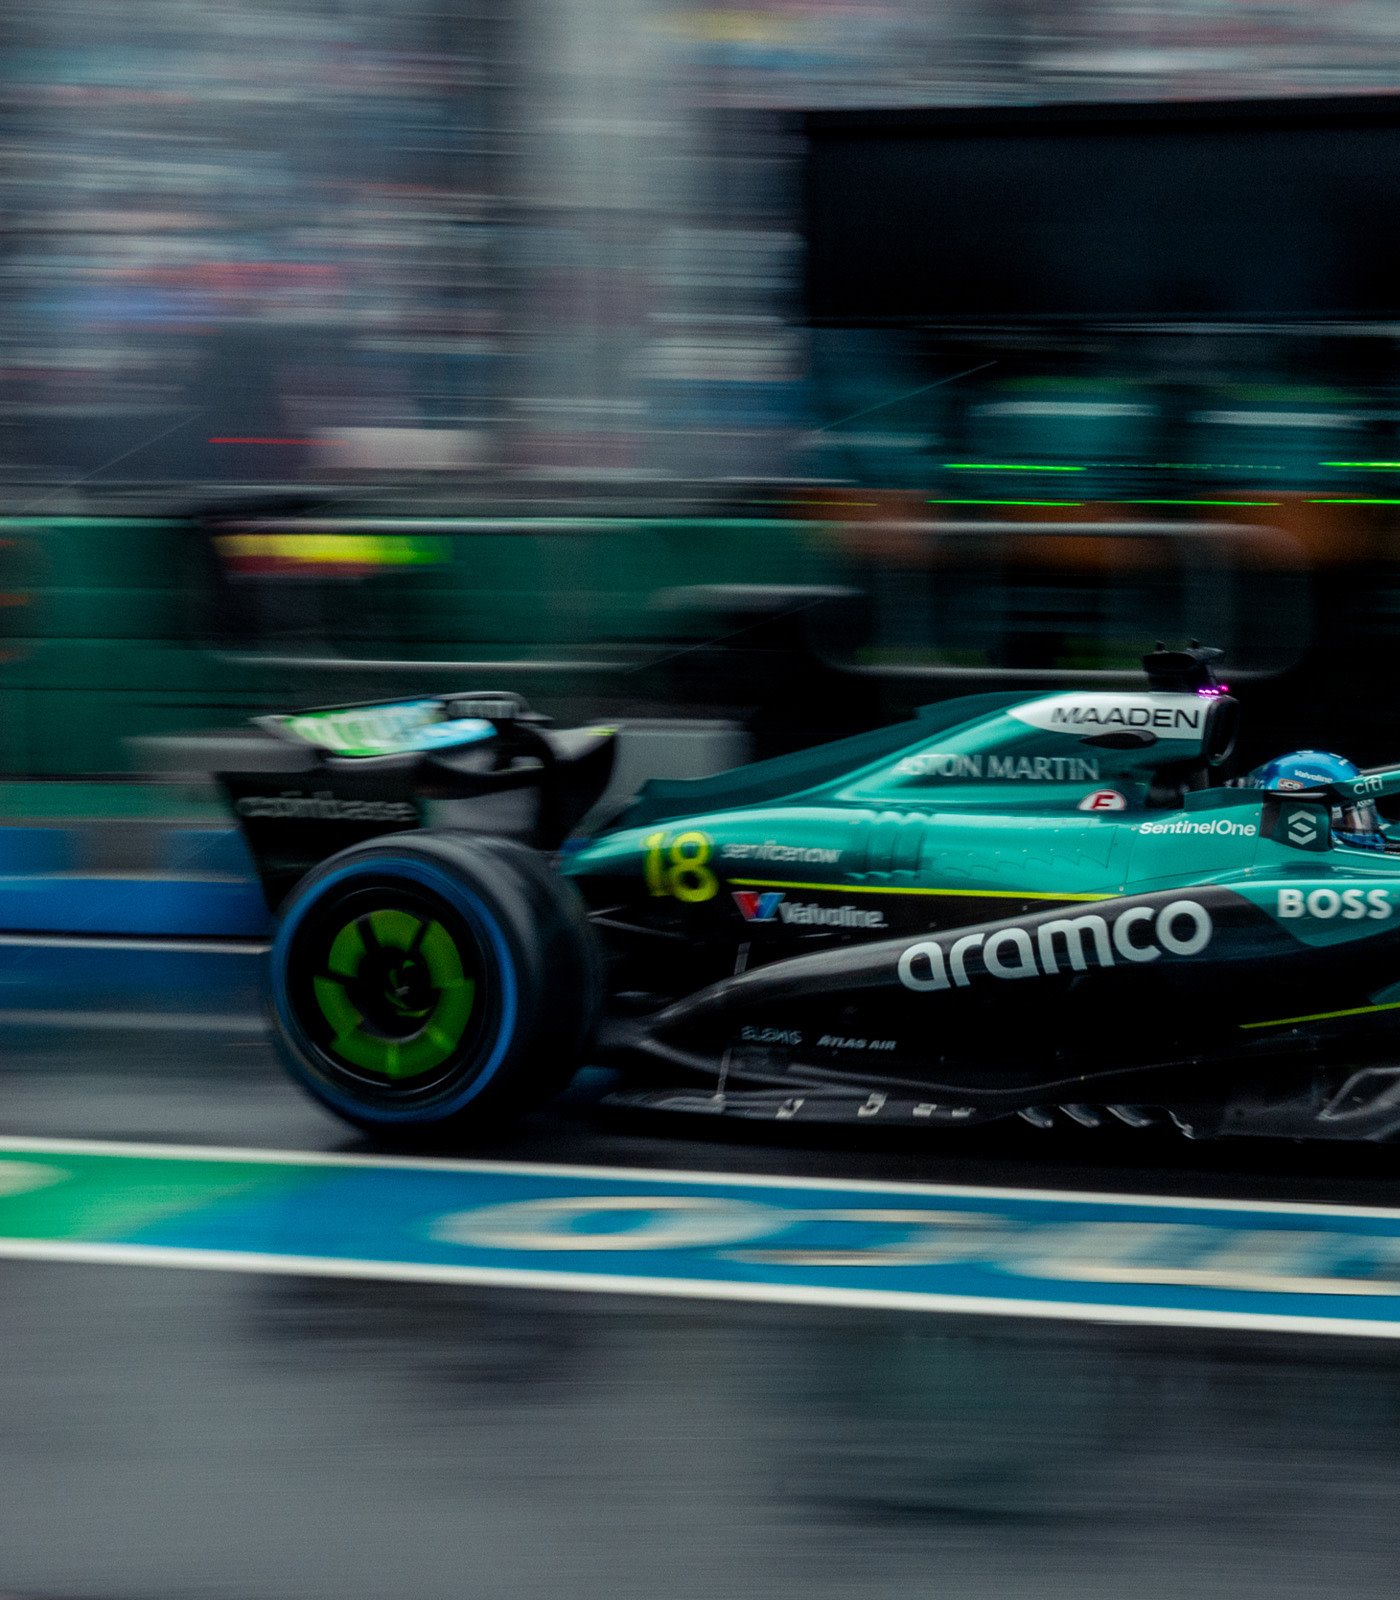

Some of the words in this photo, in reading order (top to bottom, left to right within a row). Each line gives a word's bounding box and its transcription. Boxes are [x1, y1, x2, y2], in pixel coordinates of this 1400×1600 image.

[1051, 707, 1199, 729] MAADEN
[987, 755, 1099, 781] MARTIN
[1353, 775, 1383, 795] citi
[1138, 820, 1256, 837] SentinelOne
[642, 831, 719, 902] 18
[1278, 888, 1392, 919] BOSS
[898, 899, 1213, 993] aramco
[817, 1035, 866, 1049] ATLAS
[869, 1040, 897, 1050] AIR
